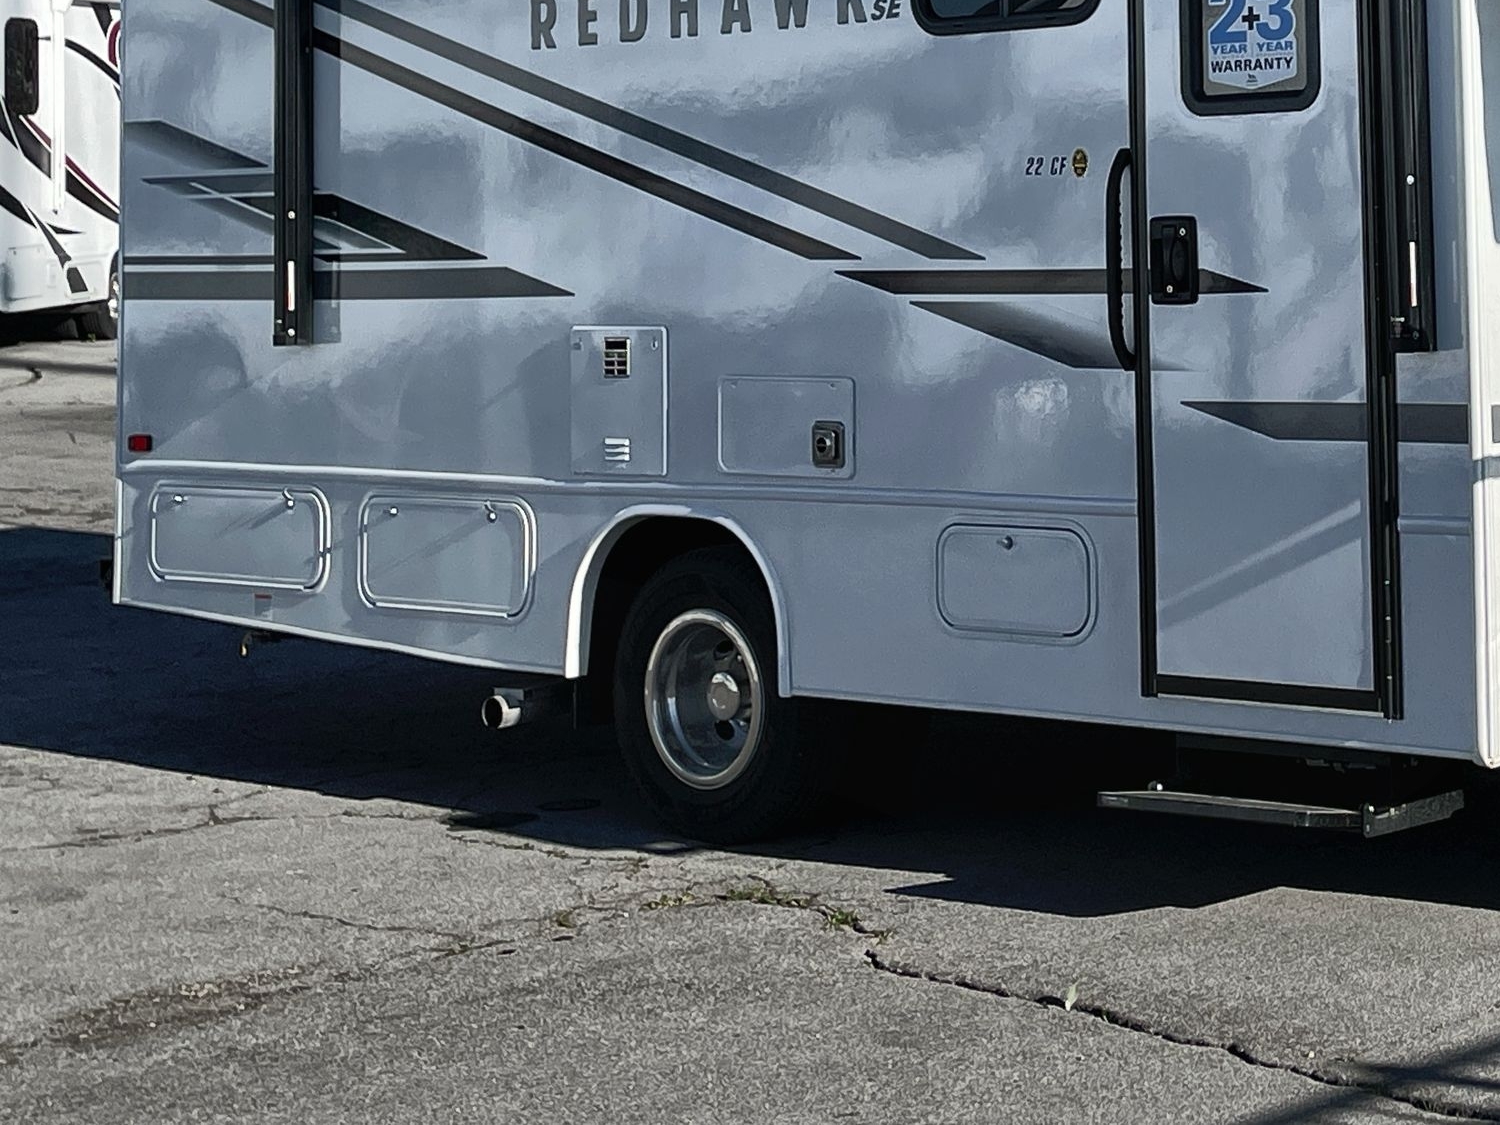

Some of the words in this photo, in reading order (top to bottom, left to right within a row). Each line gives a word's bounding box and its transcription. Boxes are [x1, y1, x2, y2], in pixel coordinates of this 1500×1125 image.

[1211, 43, 1248, 55] YEAR
[1256, 40, 1293, 52] YEAR
[1211, 57, 1293, 73] WARRANTY
[1025, 156, 1044, 176] 22
[1050, 156, 1067, 176] CF
